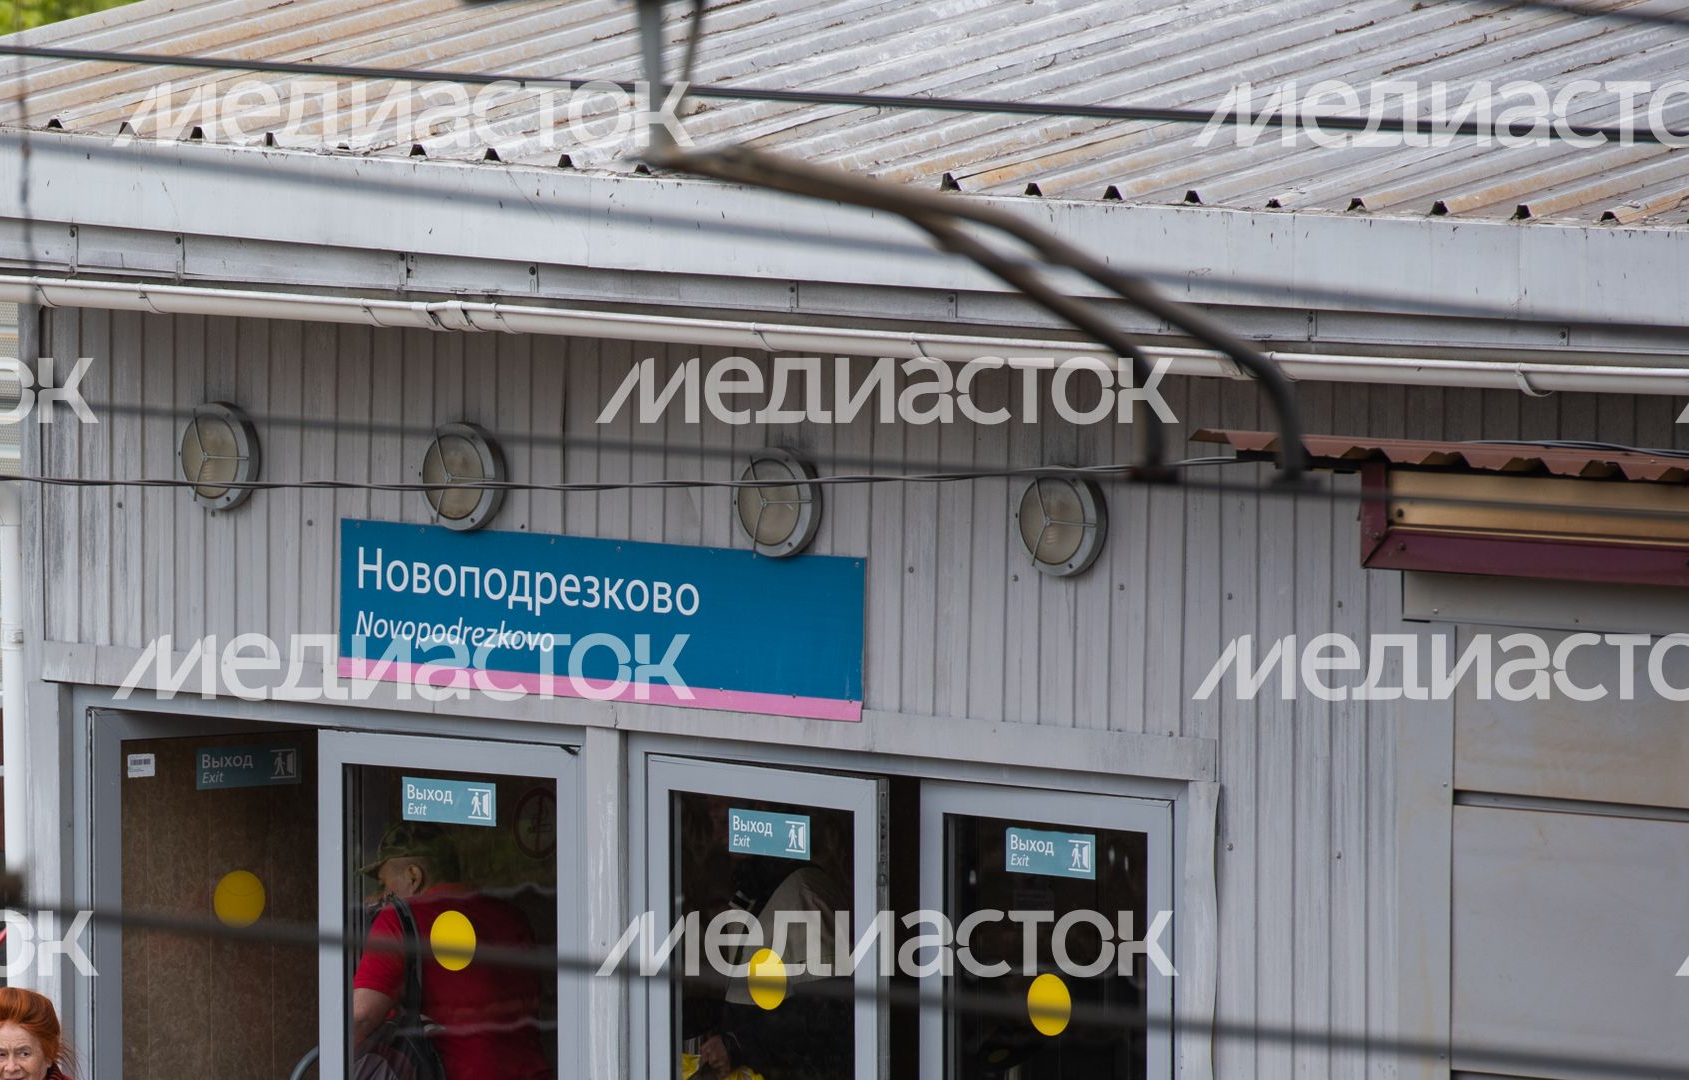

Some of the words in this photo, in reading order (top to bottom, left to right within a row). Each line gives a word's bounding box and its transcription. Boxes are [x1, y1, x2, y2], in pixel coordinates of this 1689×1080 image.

[357, 546, 701, 617] Новоподрезково
[355, 610, 555, 653] Novopodrezkovo
[201, 753, 254, 769] Выход
[202, 771, 224, 784] Exit
[407, 784, 453, 805] Выход
[407, 802, 427, 816] Exit
[732, 815, 773, 837] Выход
[733, 834, 751, 848] Exit
[1010, 834, 1054, 857] Выход
[1011, 853, 1030, 867] Exit
